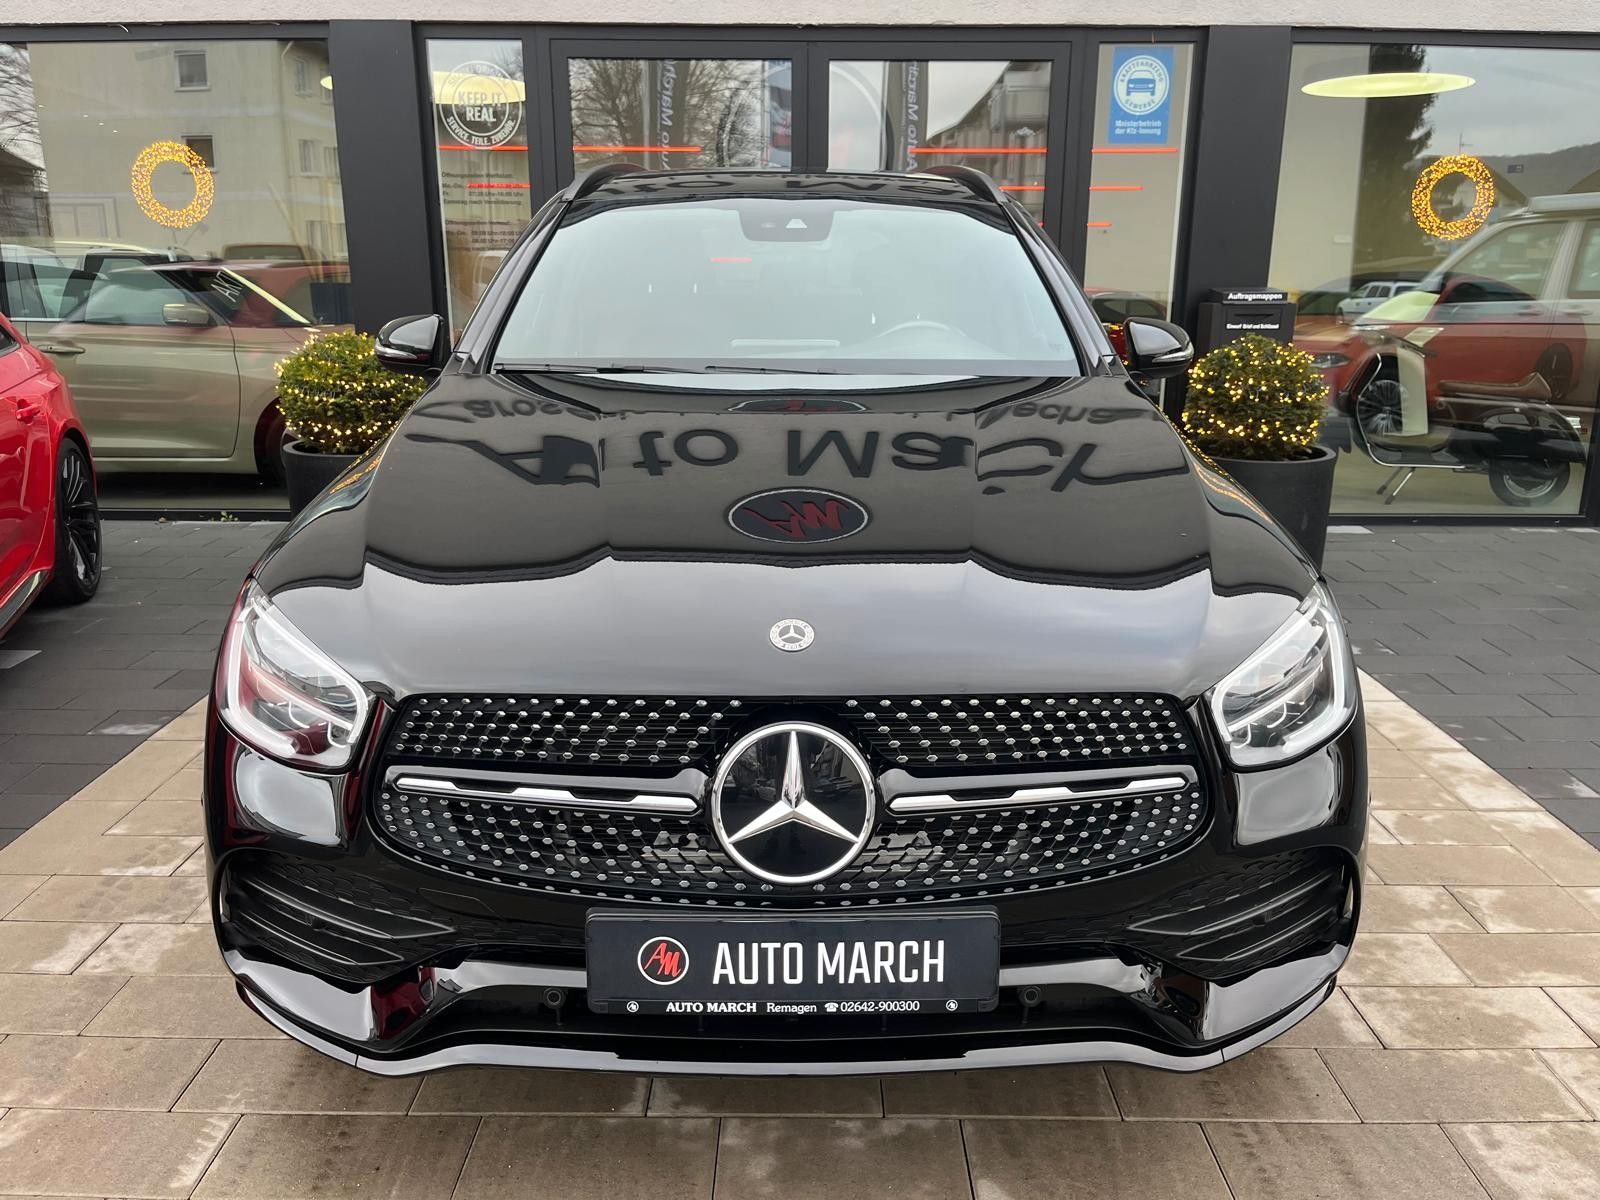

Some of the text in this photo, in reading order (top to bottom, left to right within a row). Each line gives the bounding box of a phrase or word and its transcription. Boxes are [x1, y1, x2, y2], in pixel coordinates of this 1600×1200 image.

[458, 92, 503, 107] KEEP IT
[465, 106, 497, 121] REAL
[1228, 292, 1283, 301] Auftragsmappen
[712, 940, 945, 985] AUTO MARCH
[665, 1001, 920, 1014] AUTO MARCH Remagen 02642-900300
